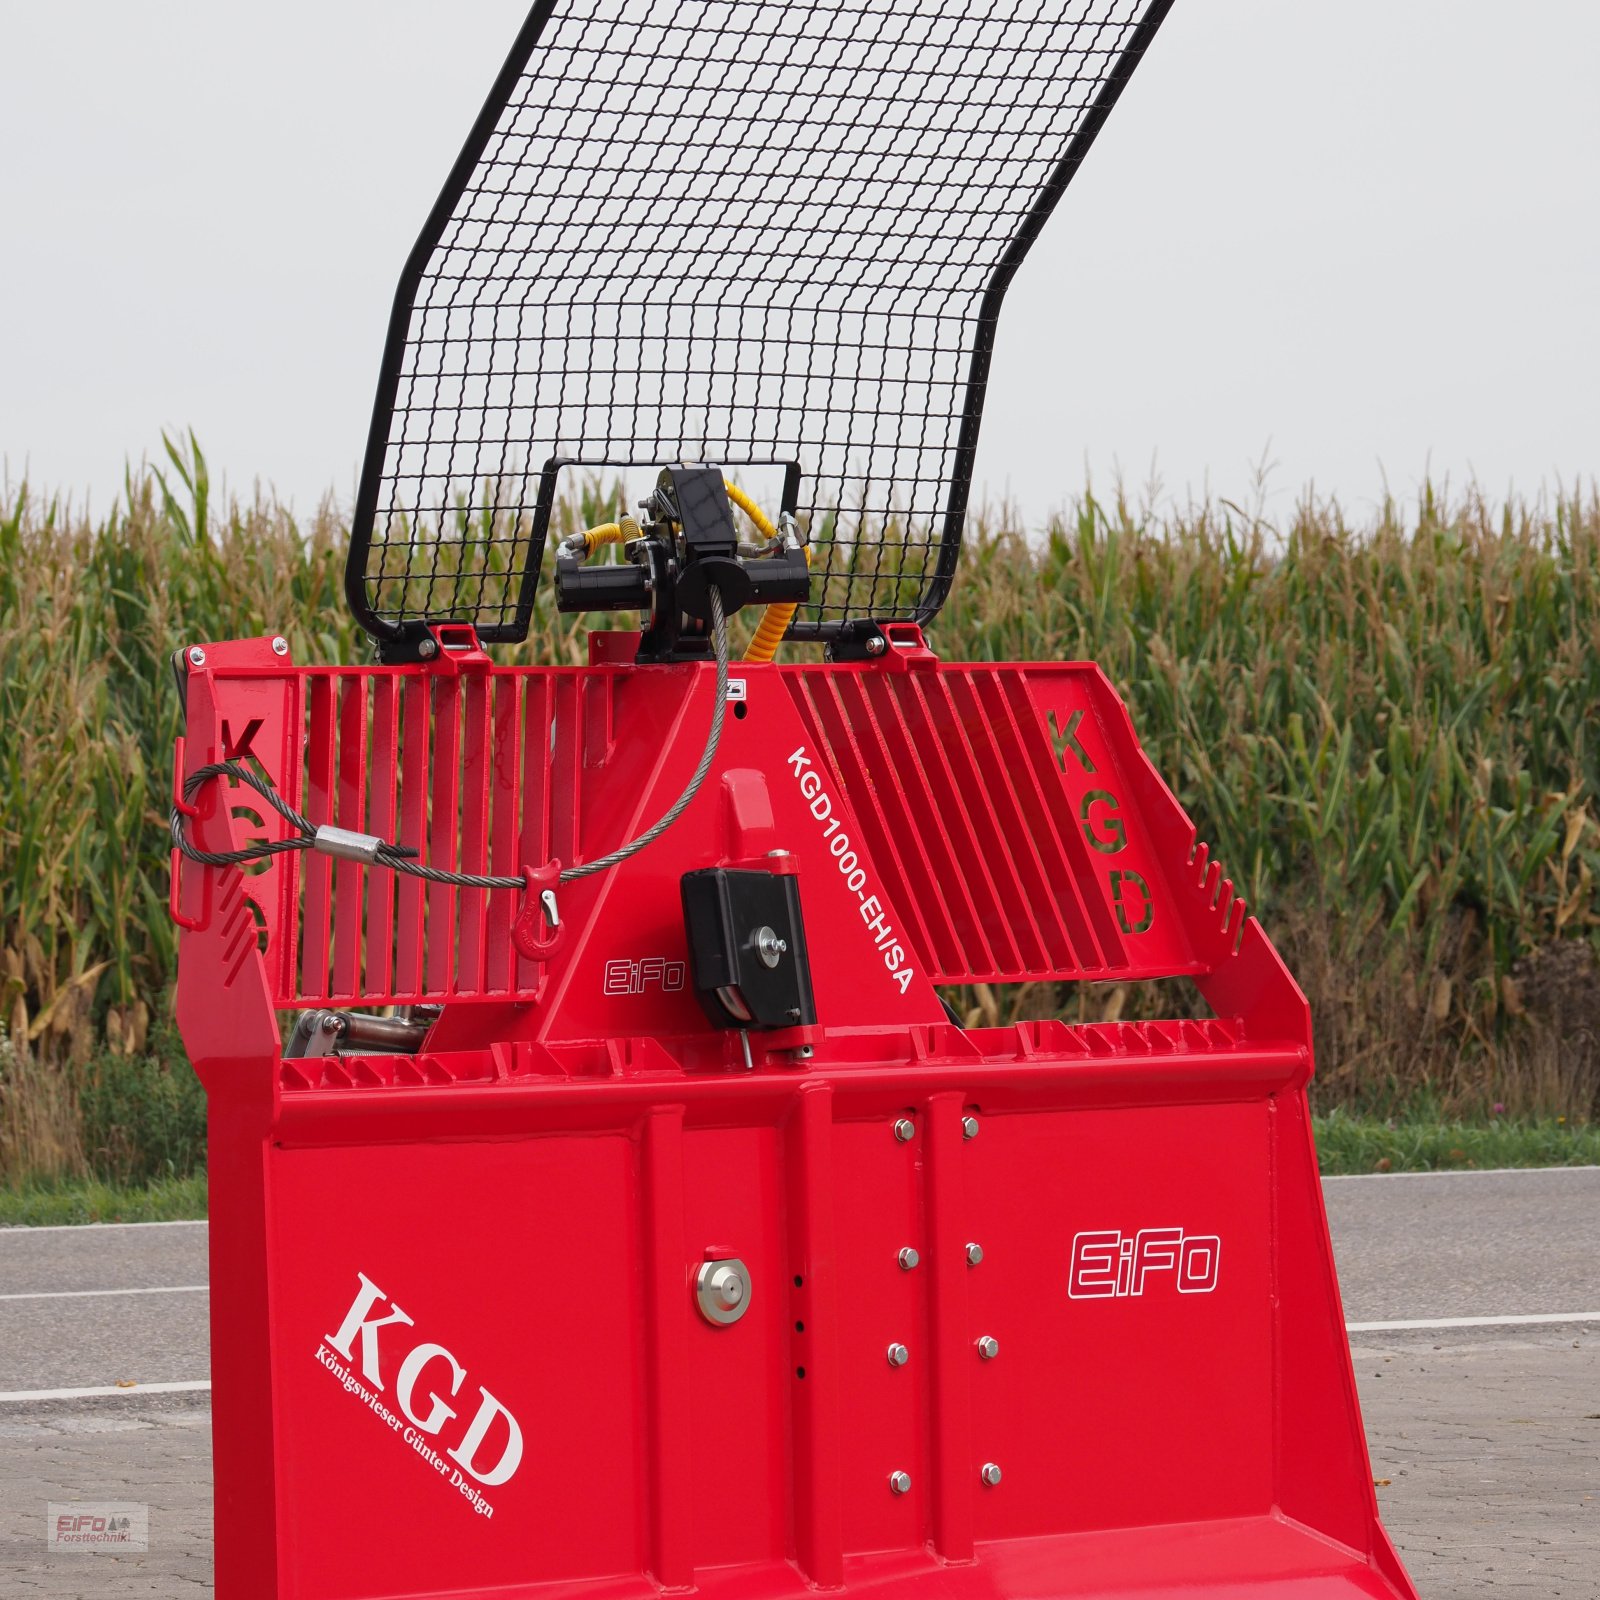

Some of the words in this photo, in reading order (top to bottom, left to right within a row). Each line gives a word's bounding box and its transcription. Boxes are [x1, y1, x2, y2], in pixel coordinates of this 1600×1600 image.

[787, 746, 914, 994] KGD1000-EHISA
[1046, 709, 1155, 934] KGD
[603, 957, 686, 996] EiFo
[1067, 1227, 1221, 1300] EiFo
[314, 1344, 404, 1432] Königswieser
[403, 1426, 450, 1476] Günter
[449, 1468, 495, 1519] Design
[324, 1271, 524, 1486] KGD
